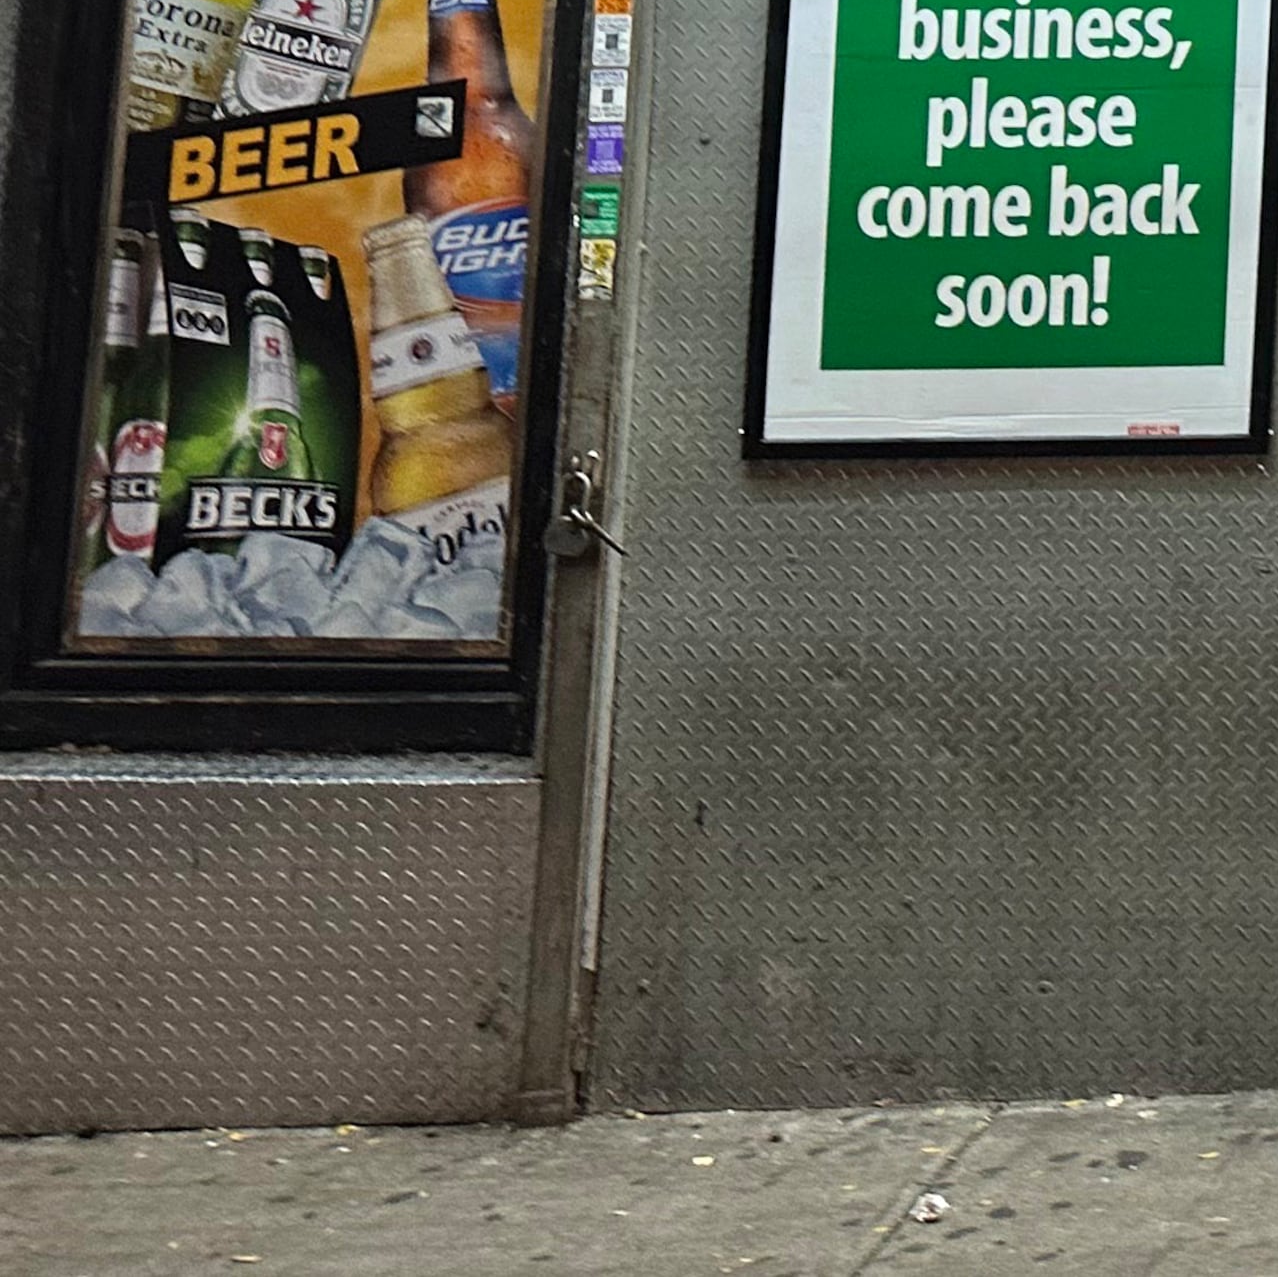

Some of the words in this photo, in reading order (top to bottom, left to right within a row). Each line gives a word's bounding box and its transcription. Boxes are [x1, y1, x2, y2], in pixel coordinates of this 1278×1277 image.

[169, 113, 360, 202] BEER
[925, 76, 1137, 168] please
[857, 183, 1031, 239] come
[1048, 163, 1202, 237] back
[934, 255, 1112, 328] soon!
